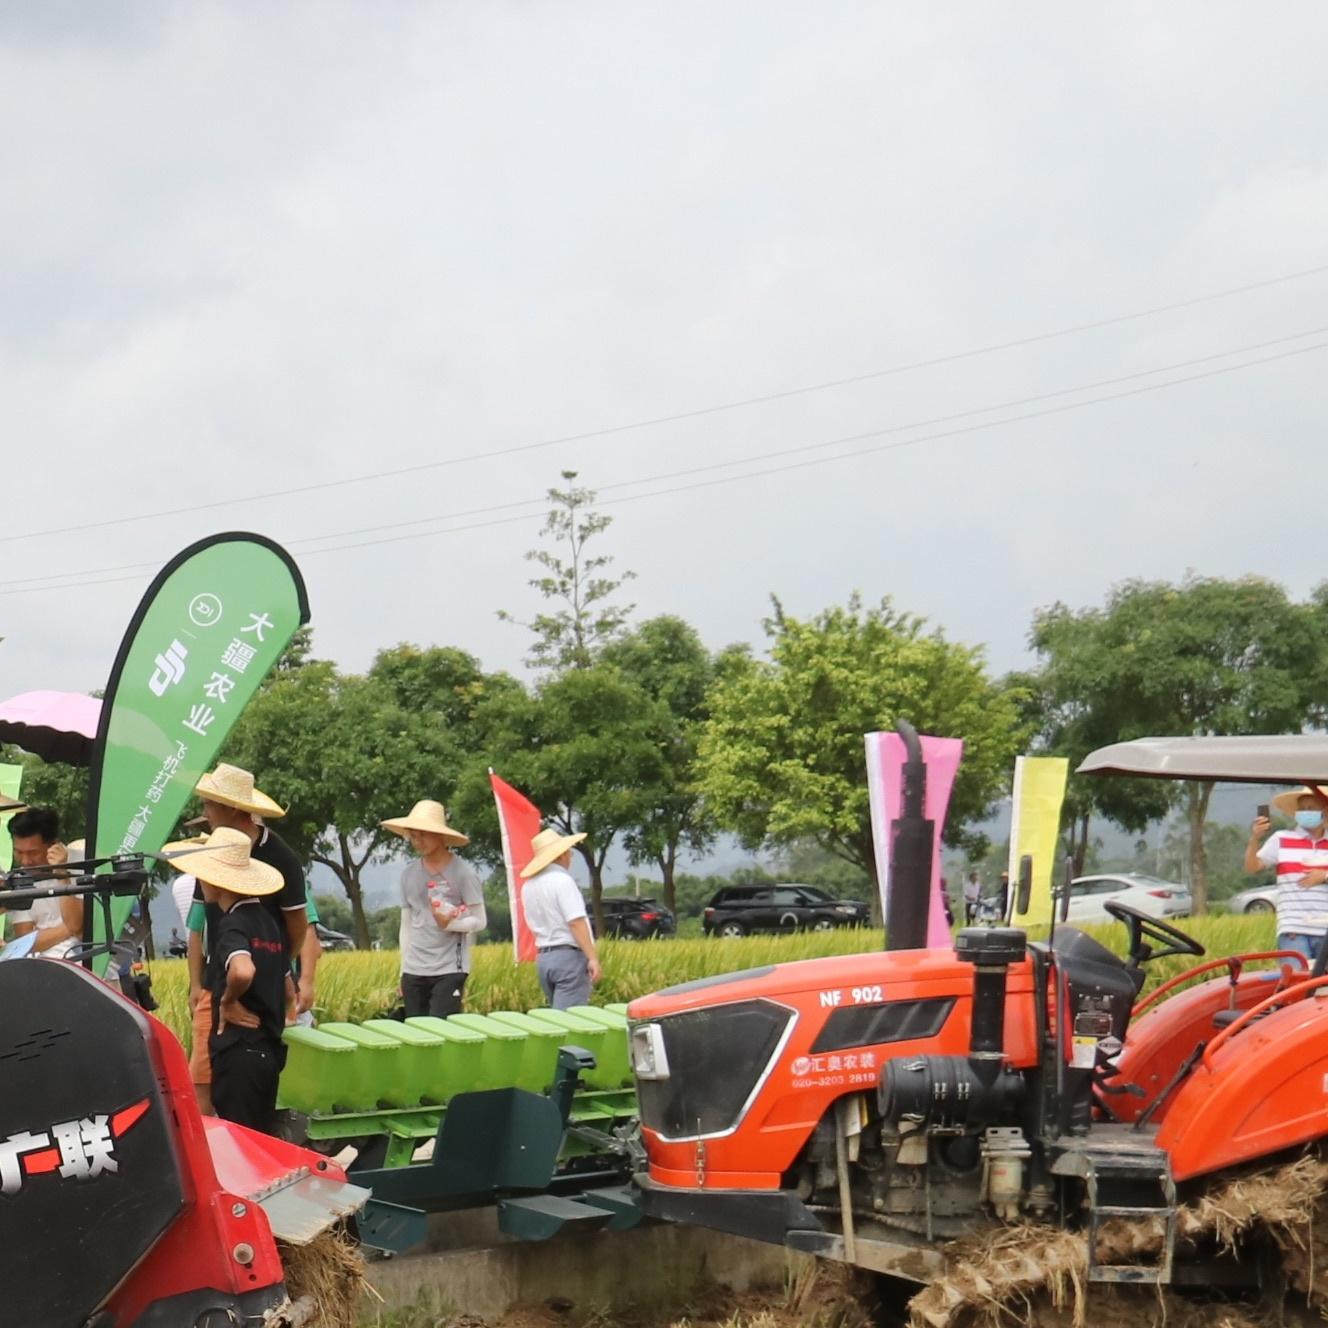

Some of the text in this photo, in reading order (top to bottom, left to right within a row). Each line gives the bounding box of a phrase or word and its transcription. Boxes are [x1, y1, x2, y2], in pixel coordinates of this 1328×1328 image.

[182, 612, 275, 737] 大疆农业
[144, 739, 189, 804] 飞机打药
[819, 985, 883, 1008] NF 902
